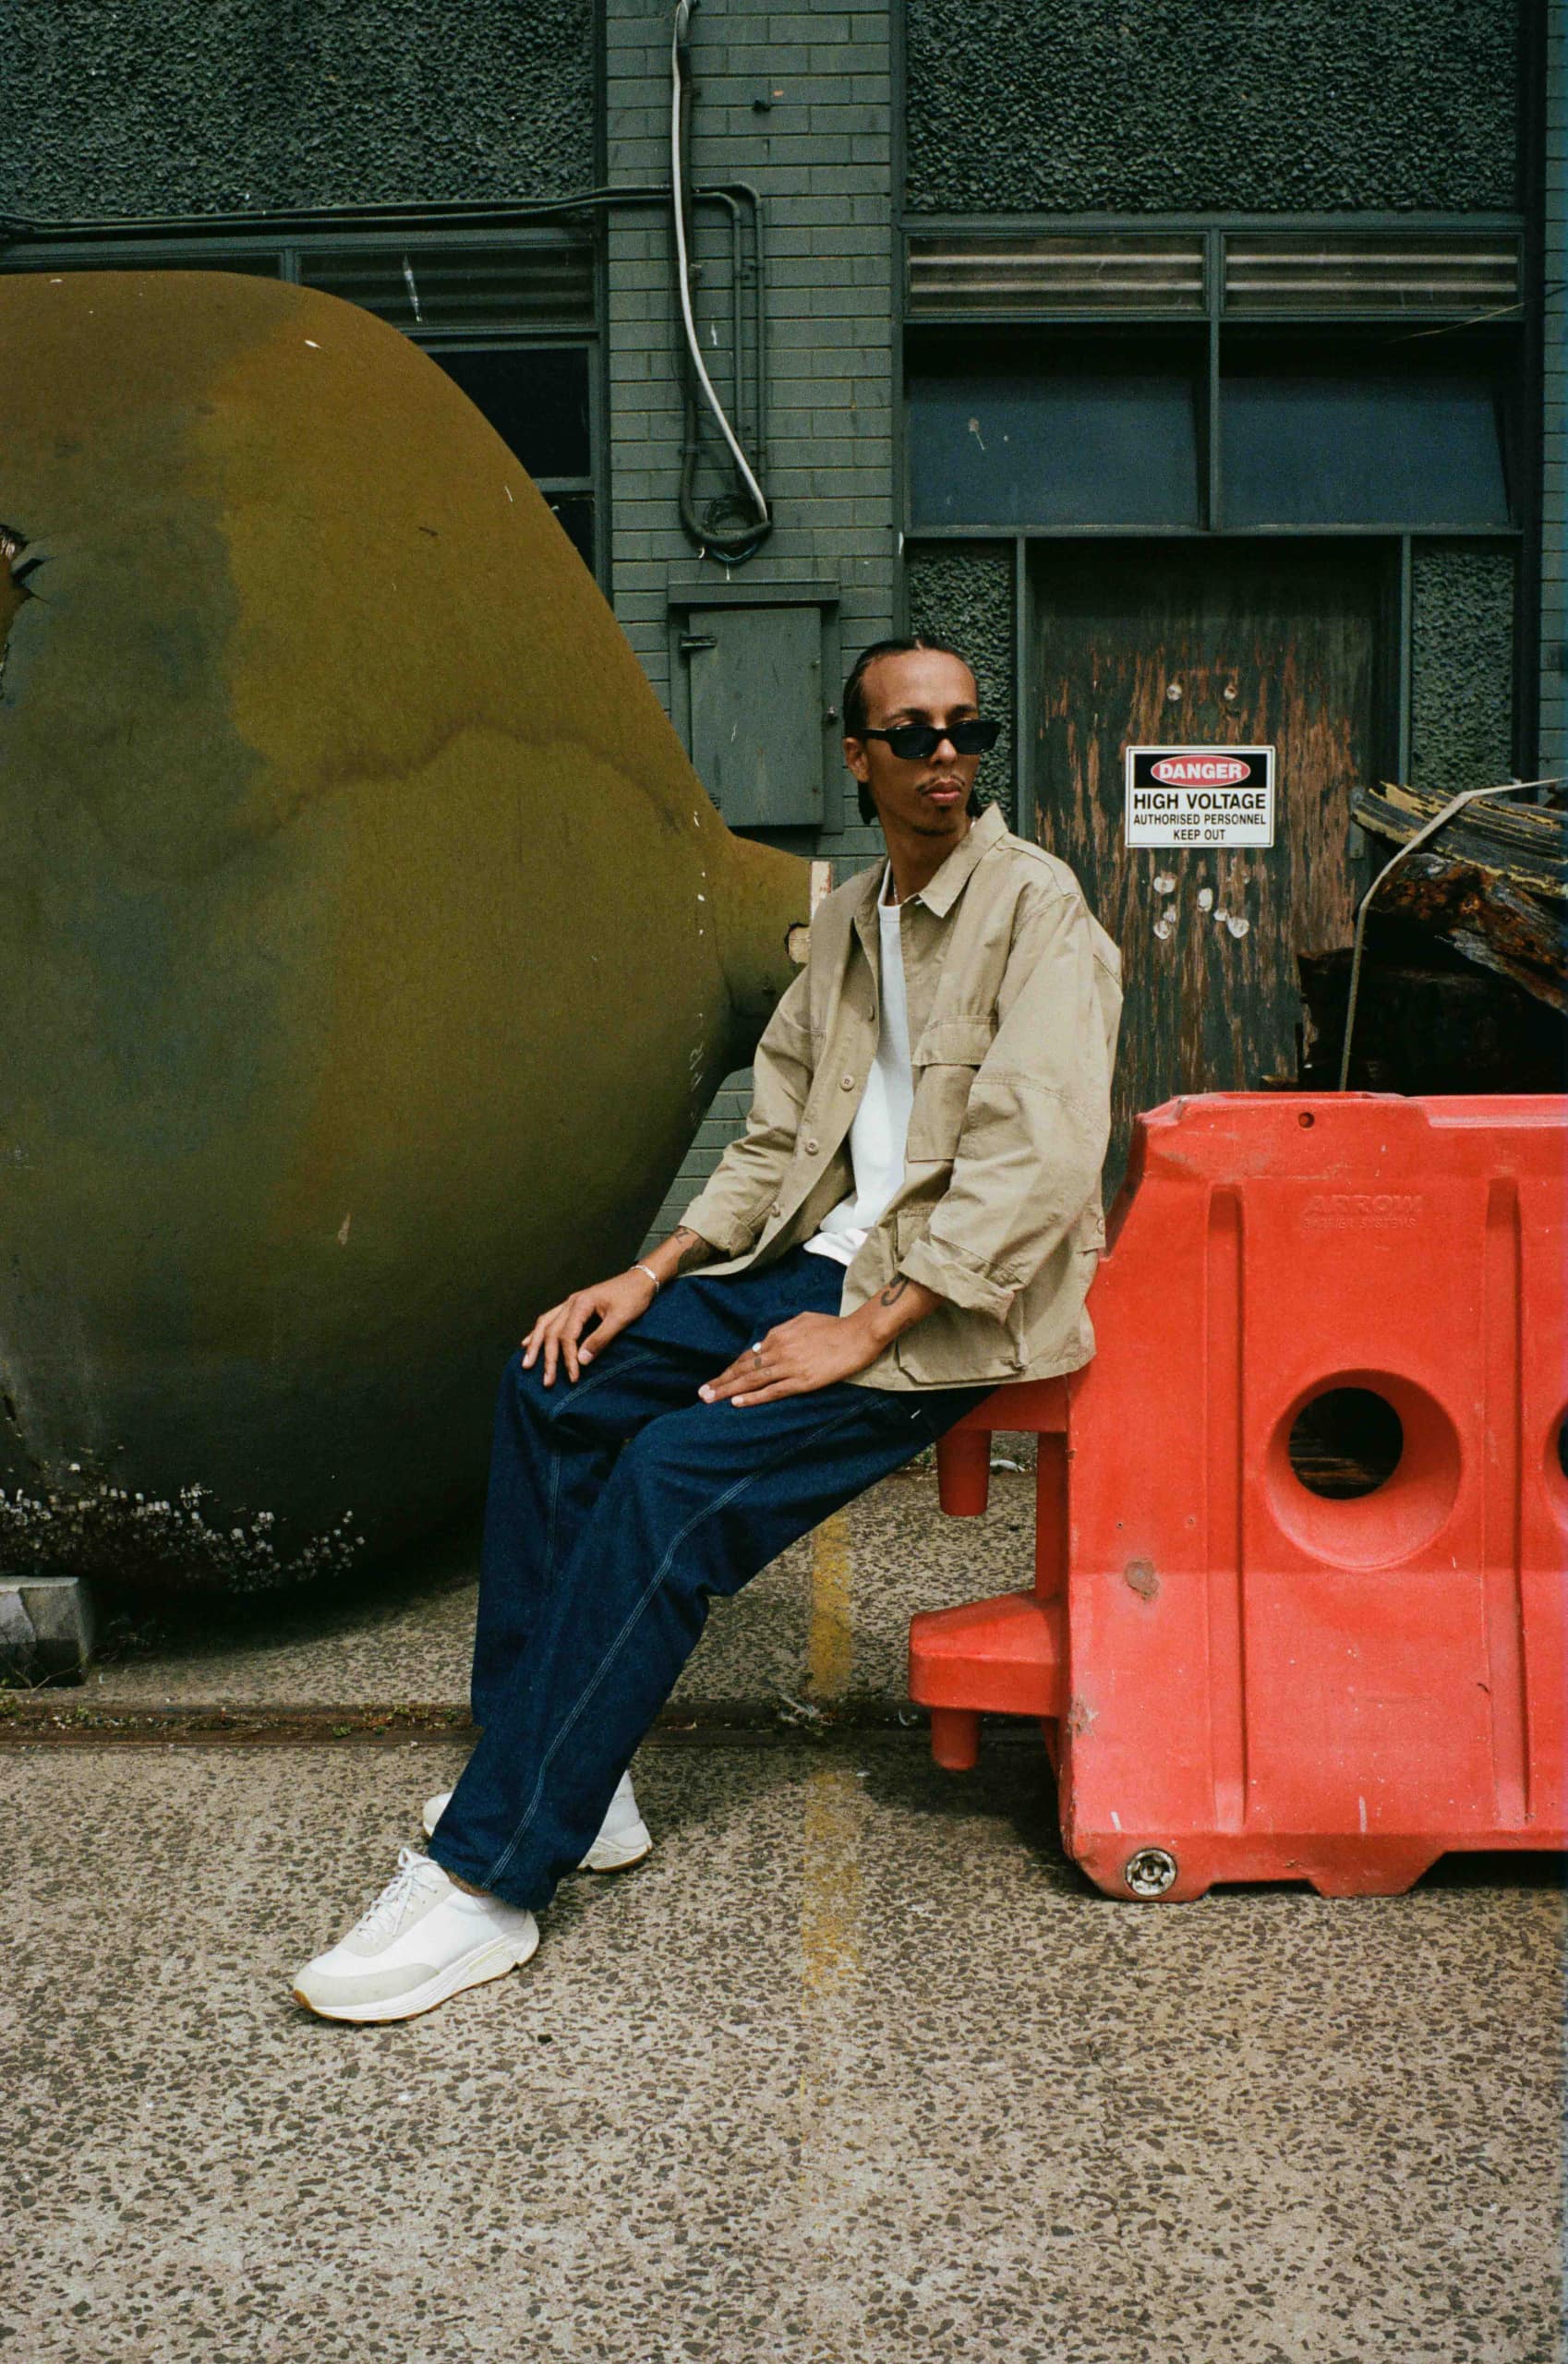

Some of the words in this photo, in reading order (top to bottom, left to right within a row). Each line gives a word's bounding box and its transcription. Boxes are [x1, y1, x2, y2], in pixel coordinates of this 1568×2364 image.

[1159, 763, 1242, 779] DANGER
[1134, 793, 1178, 810] HIGH
[1187, 793, 1266, 810] VOLTAGE
[1134, 814, 1200, 825] AUTHORISED
[1204, 814, 1266, 825] PERSONNEL
[1174, 829, 1200, 840] KEEP
[1204, 829, 1225, 840] OUT
